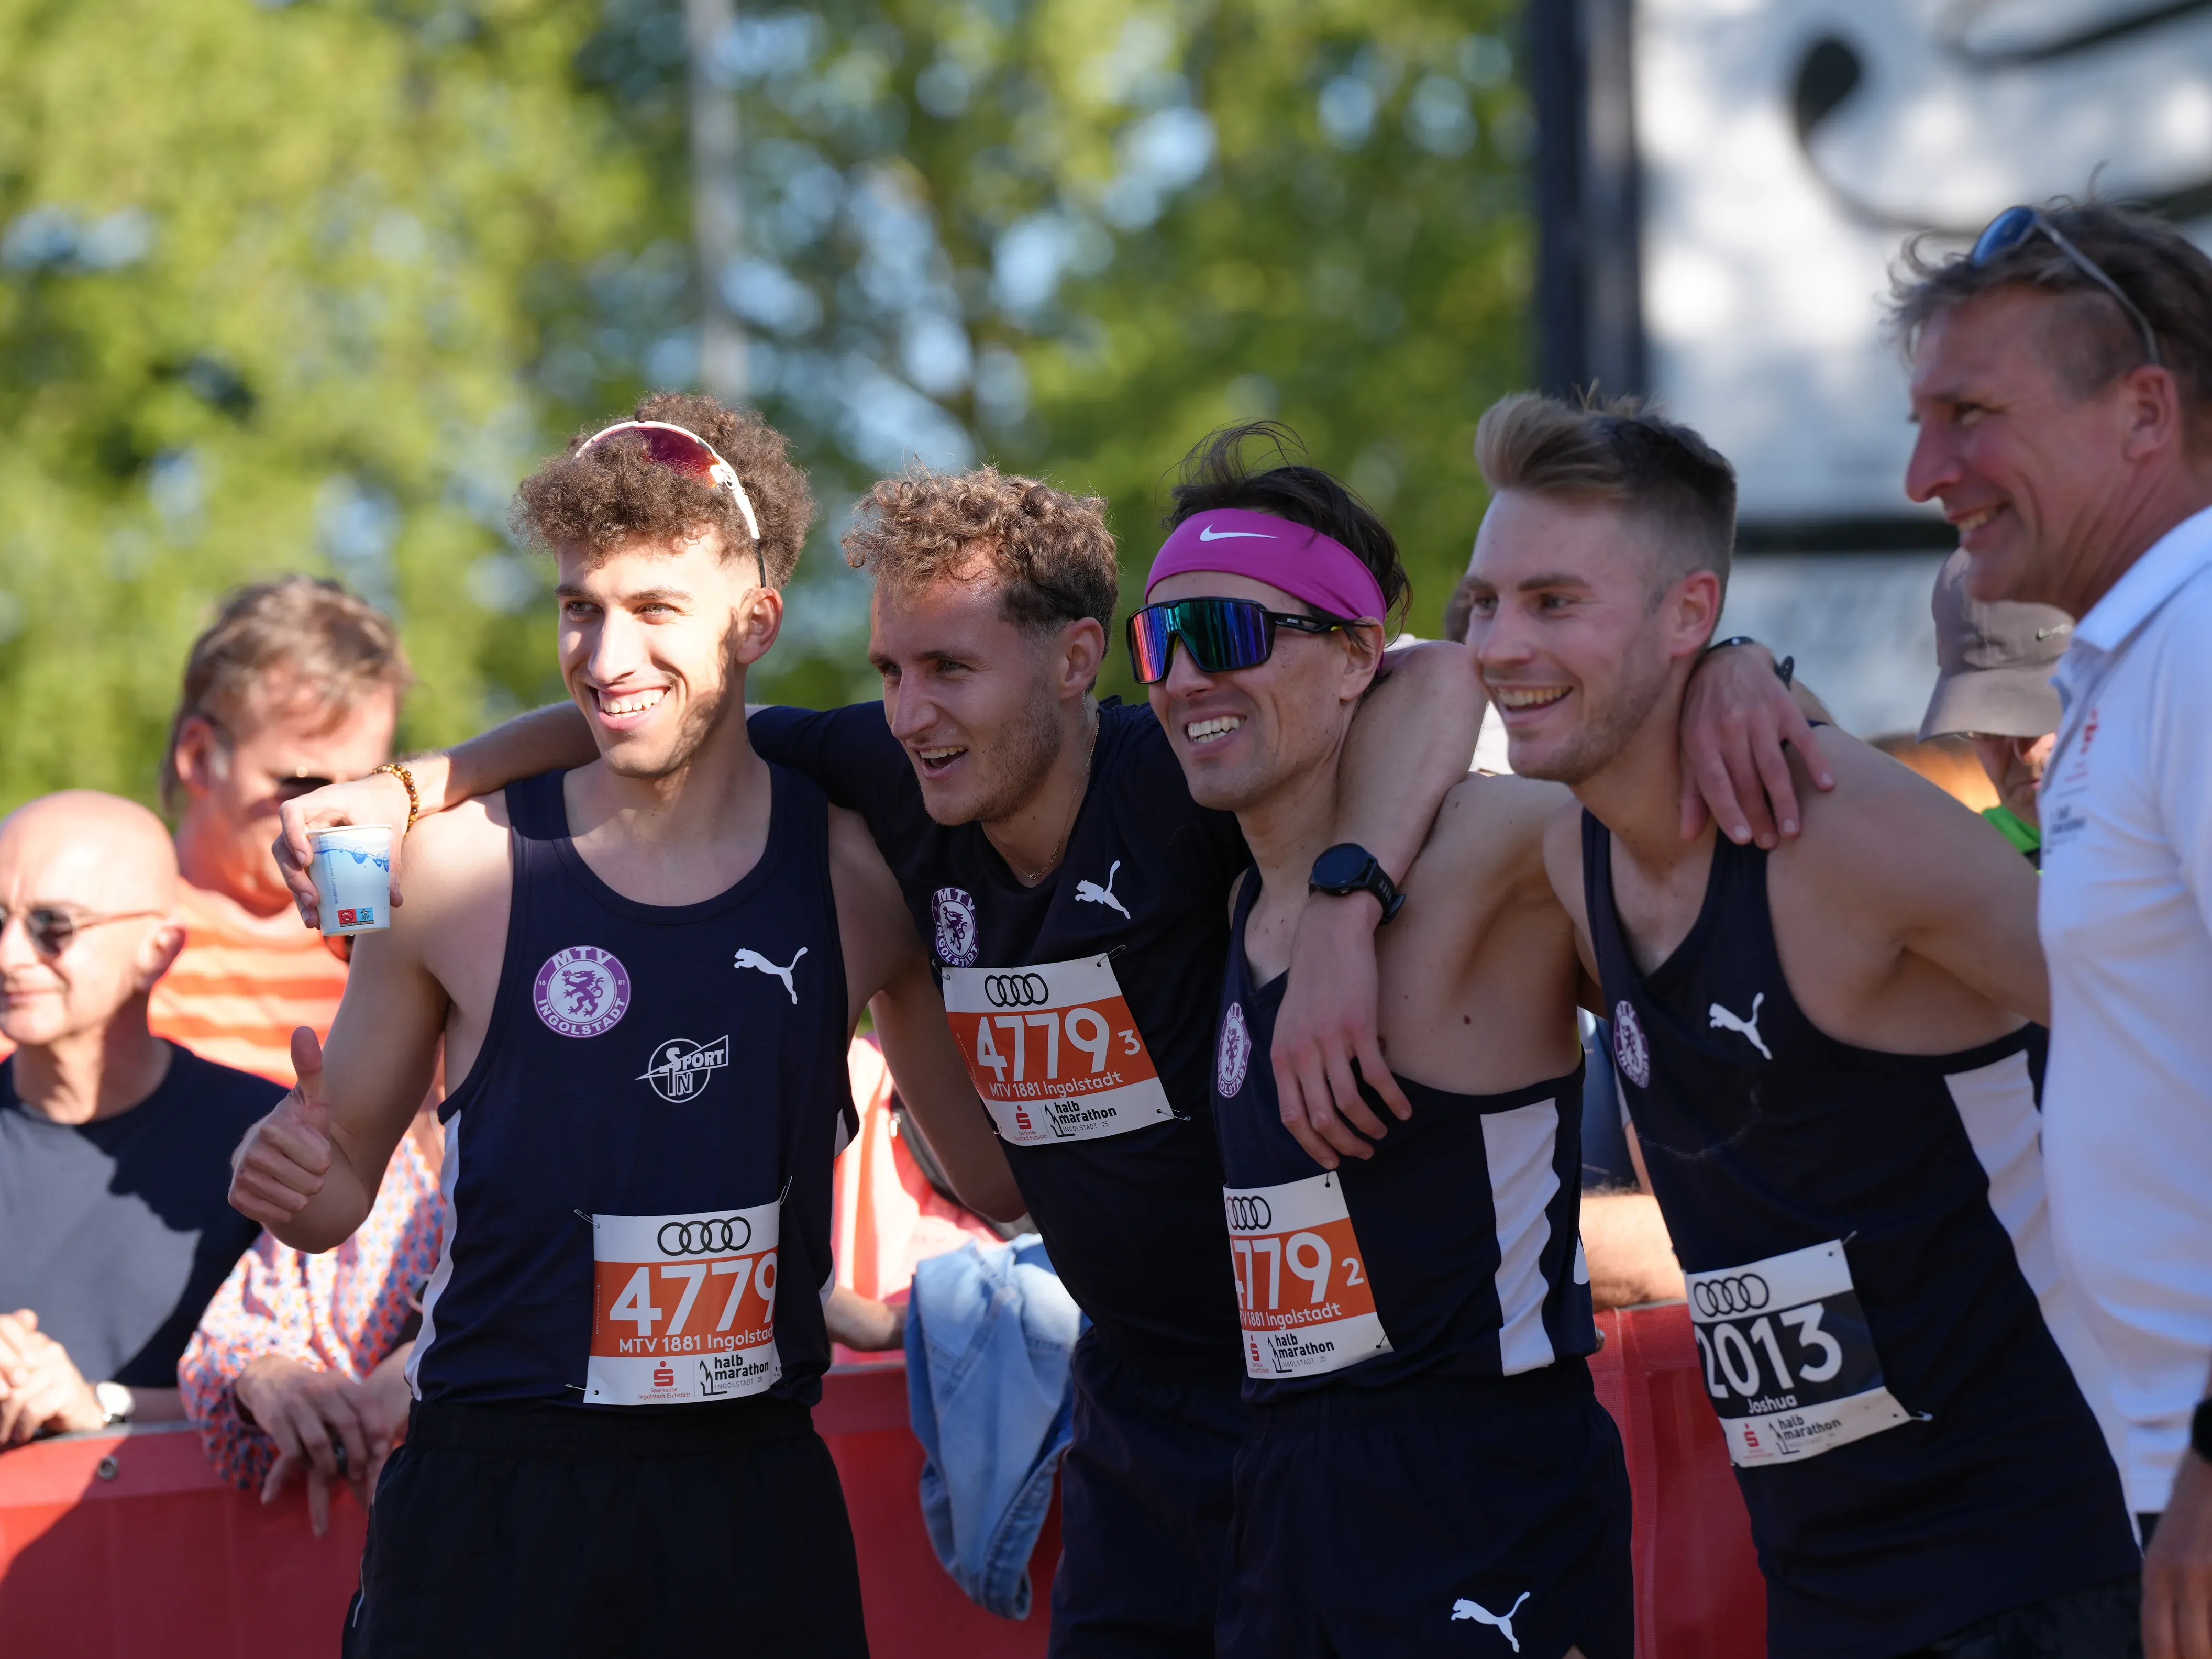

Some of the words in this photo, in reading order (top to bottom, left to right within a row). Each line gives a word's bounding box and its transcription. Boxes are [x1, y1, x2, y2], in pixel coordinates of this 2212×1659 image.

[937, 888, 975, 911] MTV
[937, 921, 978, 967] INGOLSTADT
[552, 946, 613, 970] MTV
[537, 998, 625, 1035] INGOLSTADT
[977, 1007, 1110, 1082] 4779
[1117, 1028, 1141, 1055] 3
[659, 1047, 724, 1072] SPORT
[667, 1068, 693, 1096] IN
[989, 1082, 1011, 1098] MTV
[1013, 1081, 1041, 1098] 1881
[1043, 1071, 1123, 1098] Ingolstadt
[1054, 1100, 1080, 1114] halb
[1059, 1106, 1117, 1125] marathon
[1063, 1123, 1097, 1133] INGOLSTADT
[1341, 1257, 1364, 1286] 2
[610, 1252, 777, 1336] 4779
[1247, 1311, 1265, 1326] 1881
[1266, 1302, 1342, 1330] Ingolstadt
[620, 1337, 657, 1353] MTV
[662, 1335, 700, 1352] 1881
[1275, 1333, 1298, 1347] halb
[1278, 1341, 1334, 1358] marathon
[1694, 1302, 1843, 1399] 2013
[714, 1354, 743, 1369] halb
[715, 1362, 769, 1380] marathon
[1281, 1358, 1314, 1367] INGOLSTADT
[715, 1378, 754, 1389] INGOLSTADT
[1748, 1395, 1798, 1414] Joshua
[1777, 1414, 1804, 1430] halb
[1783, 1419, 1842, 1440] marathon
